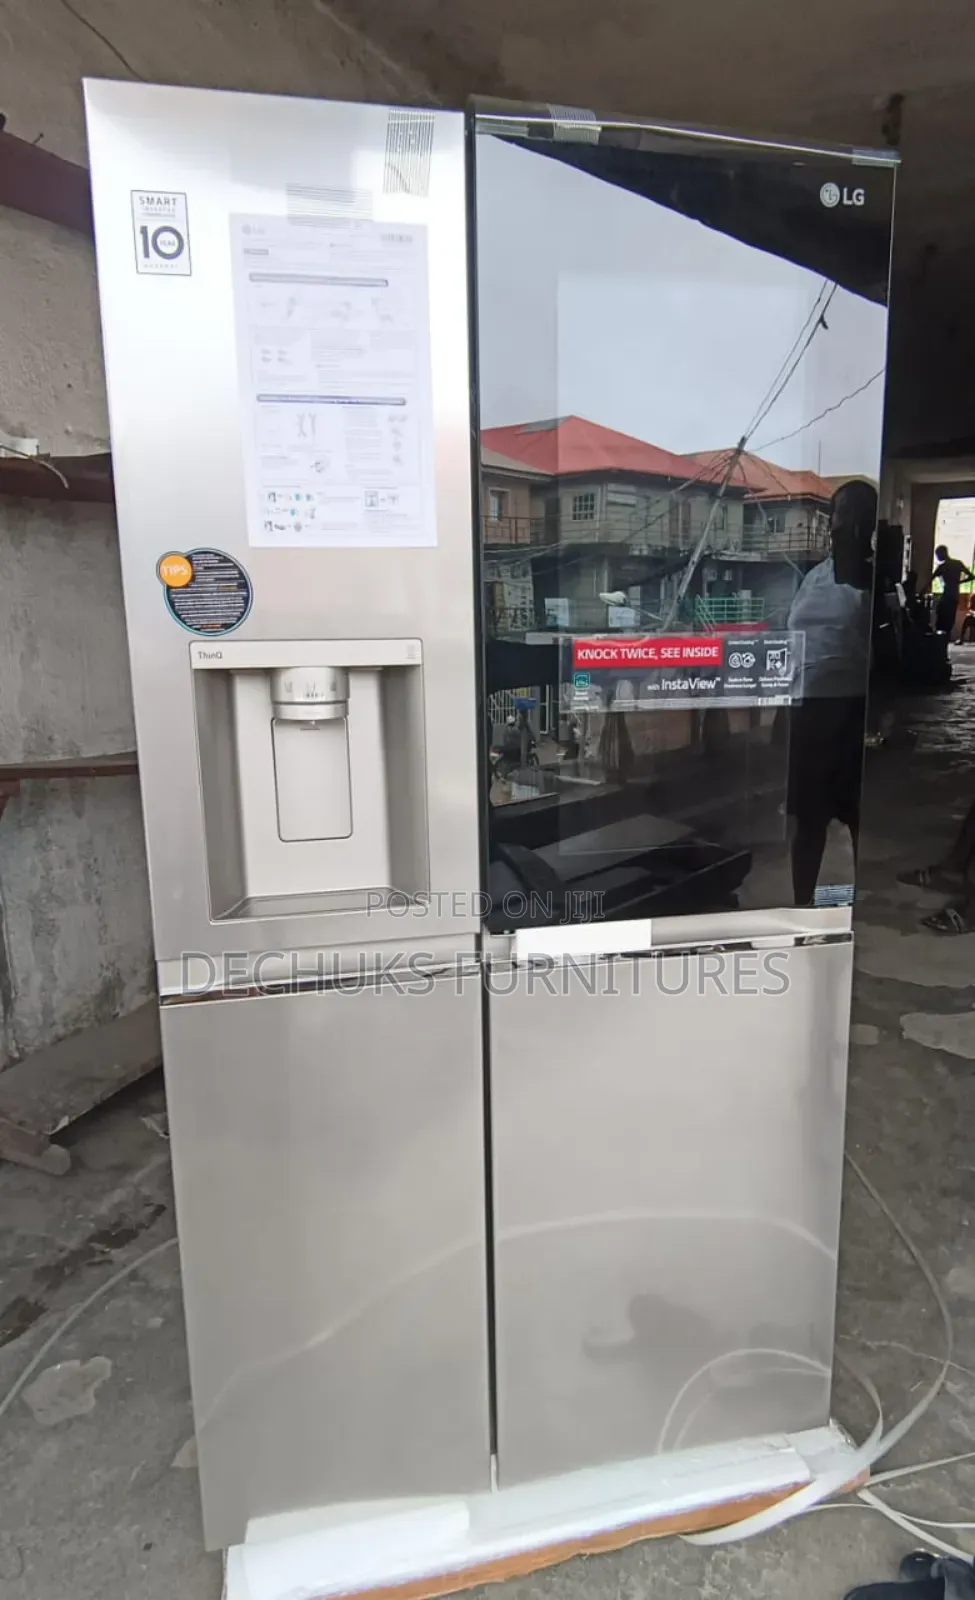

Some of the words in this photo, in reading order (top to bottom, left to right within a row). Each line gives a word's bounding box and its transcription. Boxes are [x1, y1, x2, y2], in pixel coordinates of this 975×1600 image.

[139, 195, 177, 206] SMART
[843, 187, 865, 206] LG
[140, 225, 184, 260] 10
[198, 651, 223, 661] ThinQ
[577, 648, 618, 660] KNOCK
[620, 648, 658, 660] TWICE,
[660, 647, 681, 659] SEE
[682, 646, 719, 658] INSIDE
